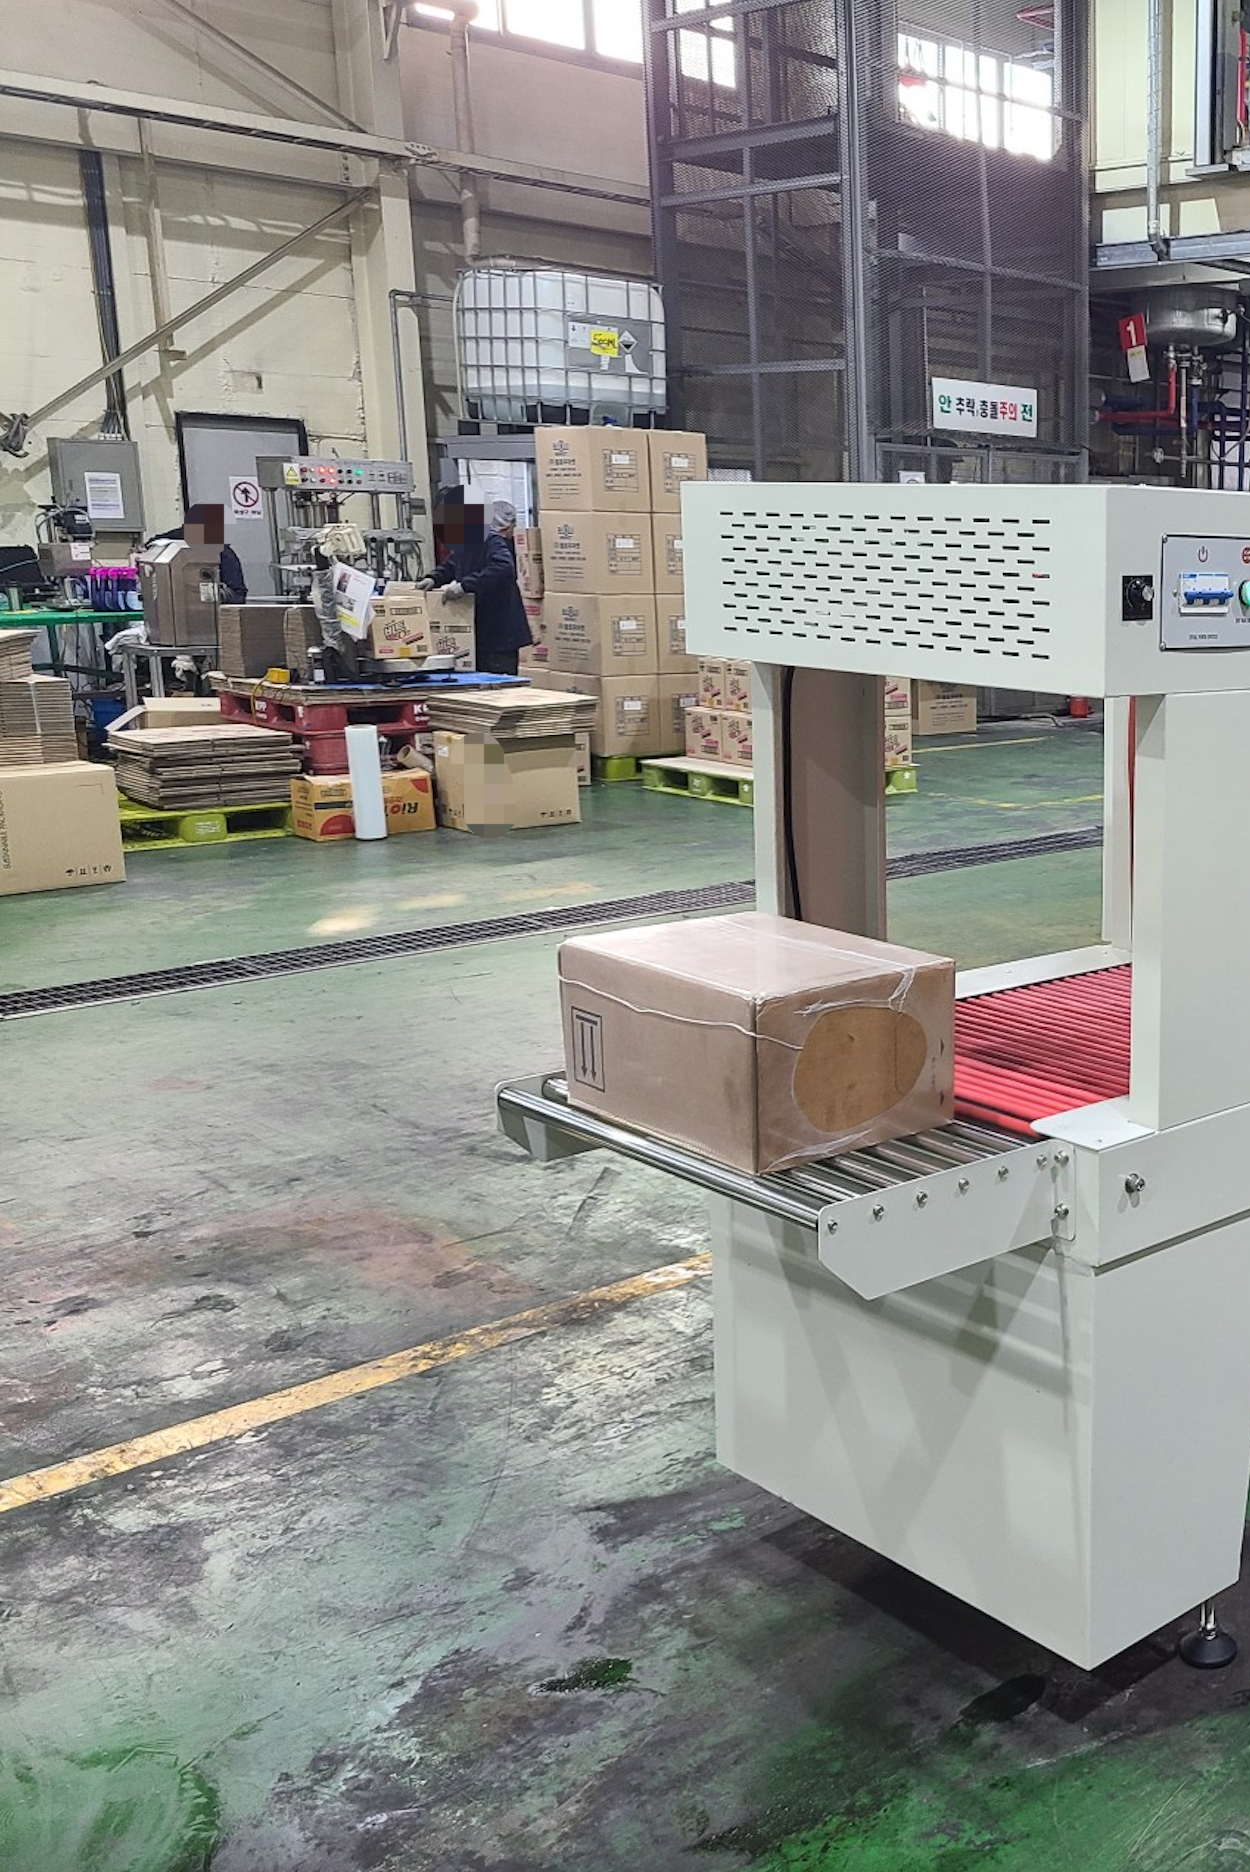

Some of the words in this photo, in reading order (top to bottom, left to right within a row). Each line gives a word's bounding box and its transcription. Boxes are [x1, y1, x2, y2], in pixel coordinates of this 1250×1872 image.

[1125, 319, 1138, 346] 1
[938, 394, 952, 414] 안
[1021, 403, 1033, 422] 전
